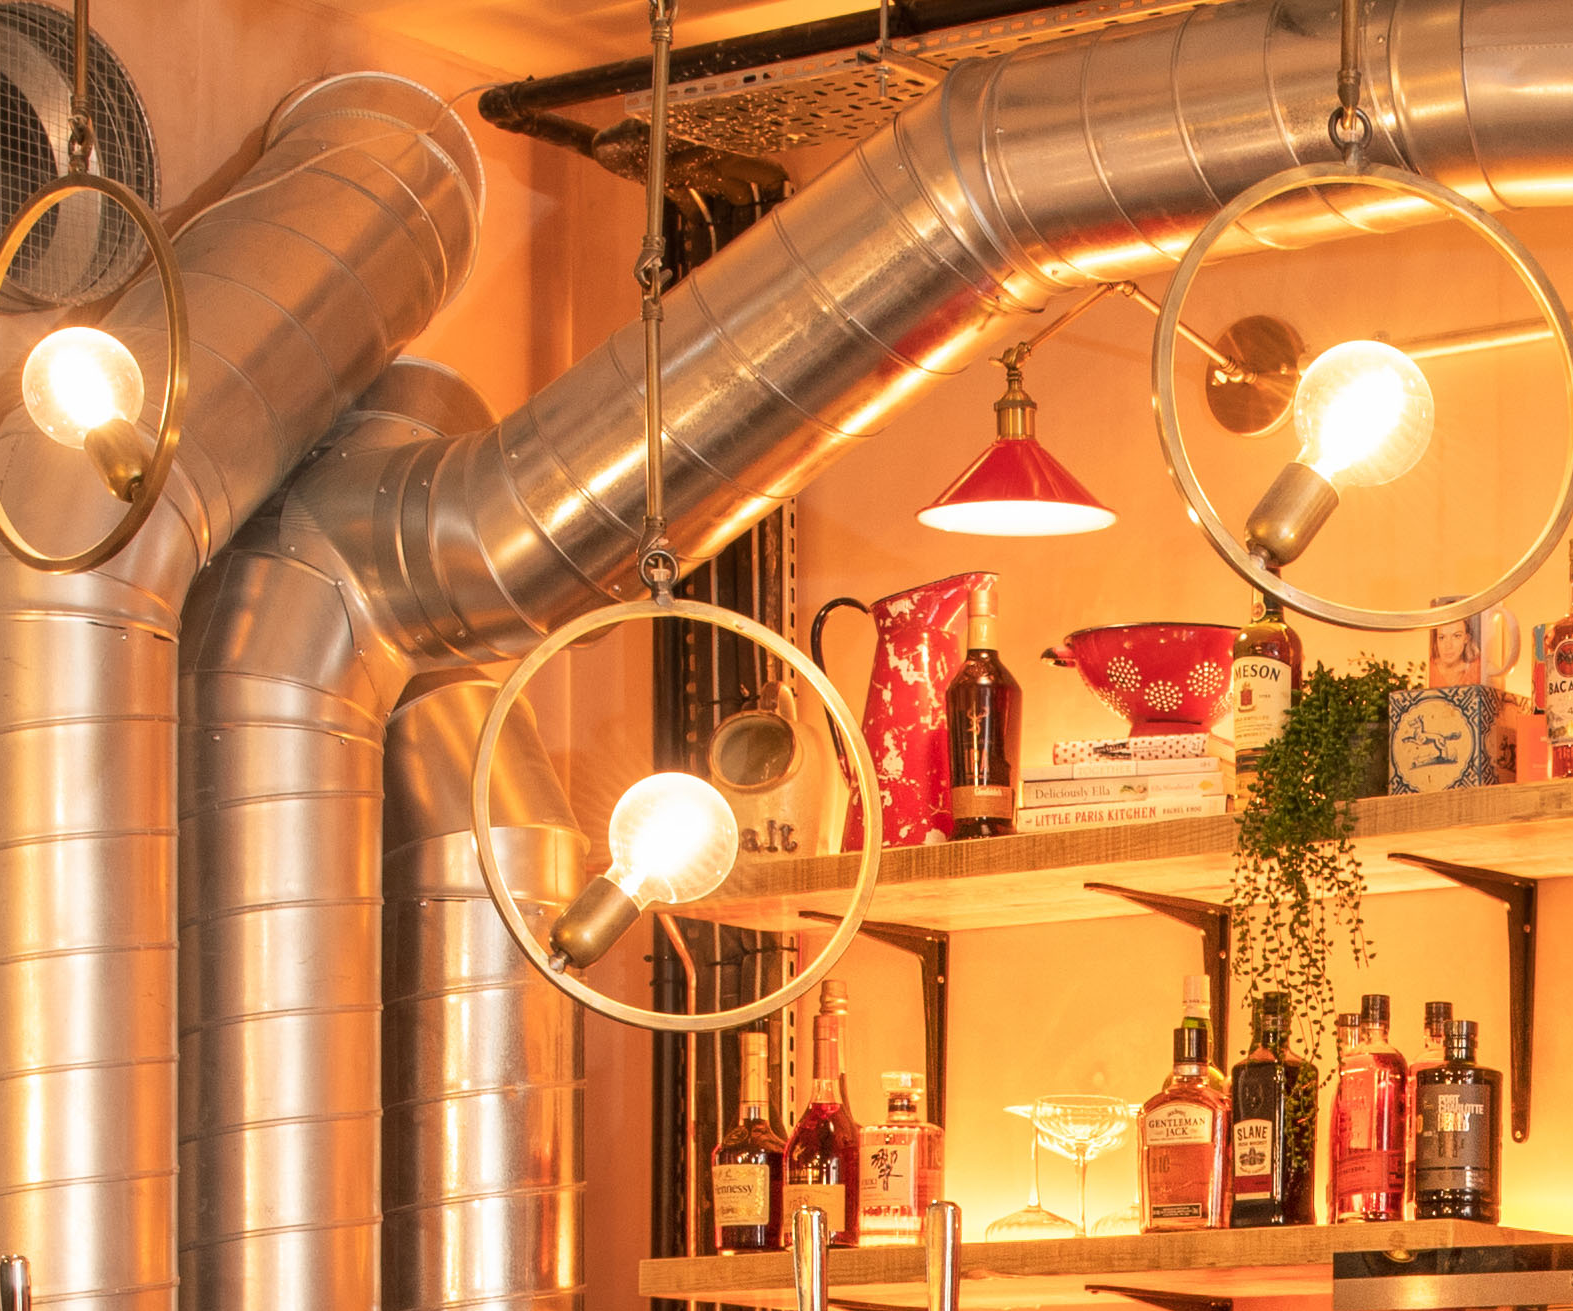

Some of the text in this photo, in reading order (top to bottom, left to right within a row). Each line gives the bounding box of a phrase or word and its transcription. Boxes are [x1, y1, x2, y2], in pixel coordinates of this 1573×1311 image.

[1035, 785, 1111, 801] Deliciously Ella
[1035, 811, 1071, 827] LITTLE
[1075, 809, 1105, 824] PARIS
[1107, 806, 1158, 822] KITCHEN
[740, 820, 797, 854] alt
[1149, 1117, 1206, 1129] GENTLEMAN
[1165, 1128, 1188, 1137] JACK
[1237, 1126, 1267, 1141] SLANE
